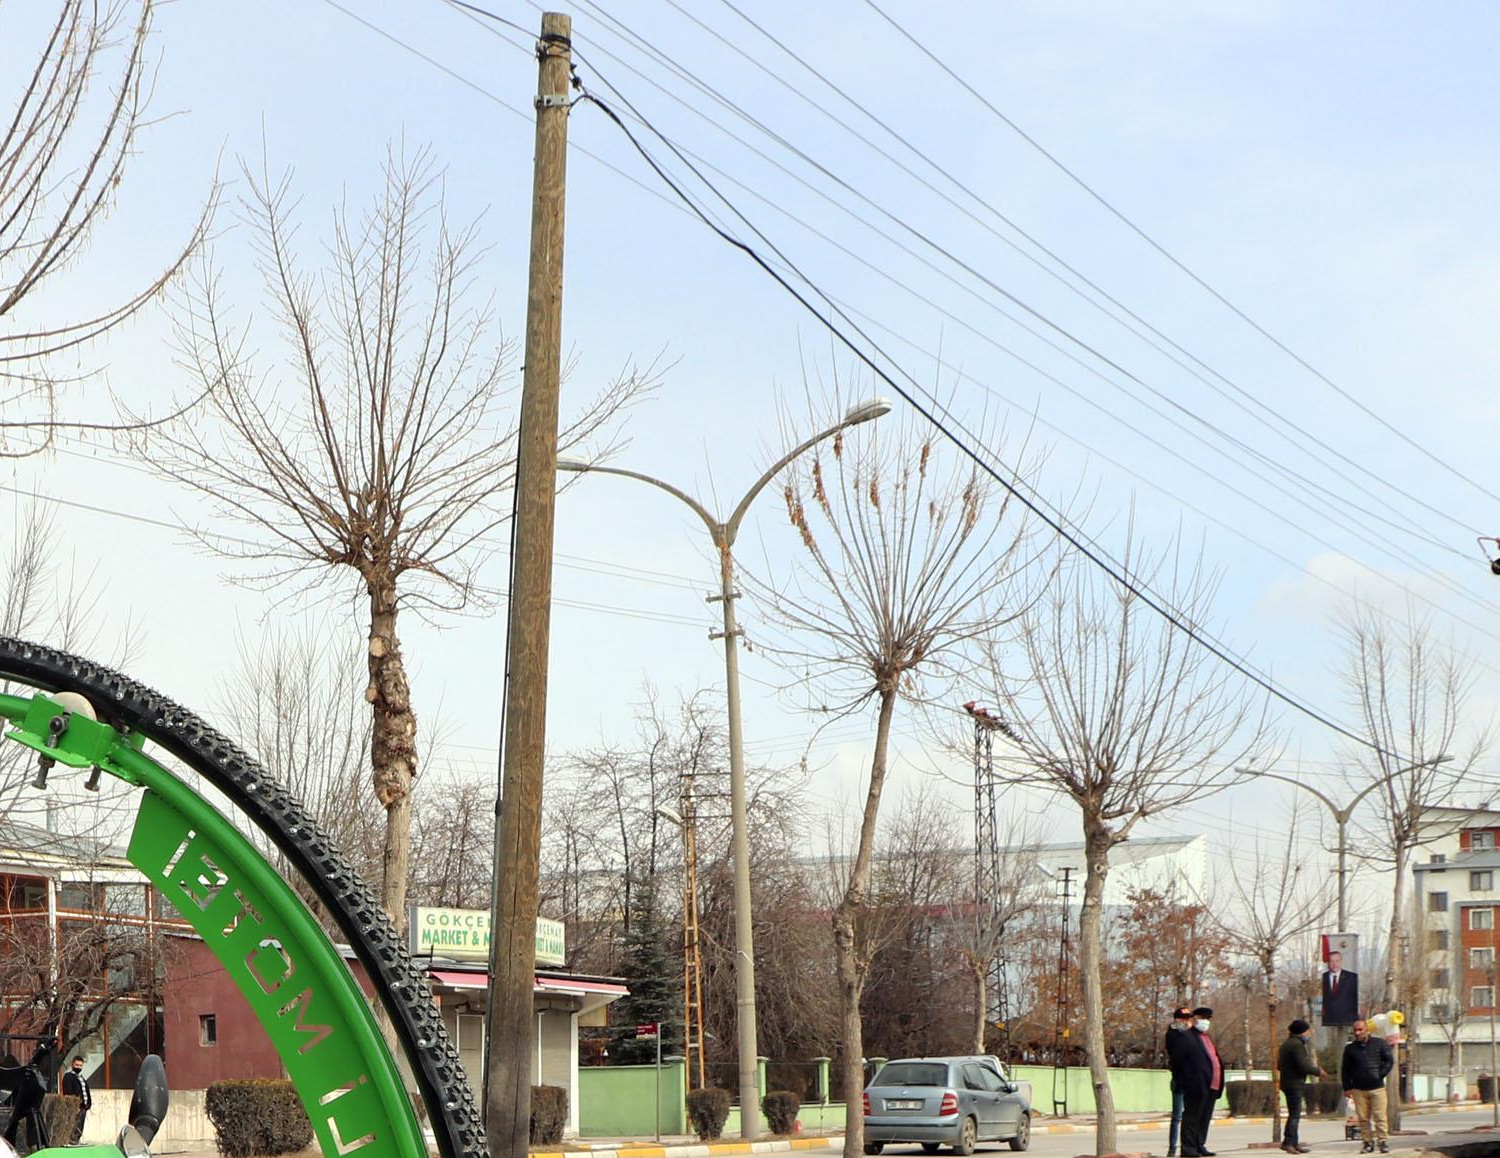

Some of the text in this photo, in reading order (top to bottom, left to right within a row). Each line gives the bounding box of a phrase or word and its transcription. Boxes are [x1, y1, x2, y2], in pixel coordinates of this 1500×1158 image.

[422, 928, 468, 945] MARKET
[472, 932, 479, 946] &
[536, 922, 562, 937] KÇENAY
